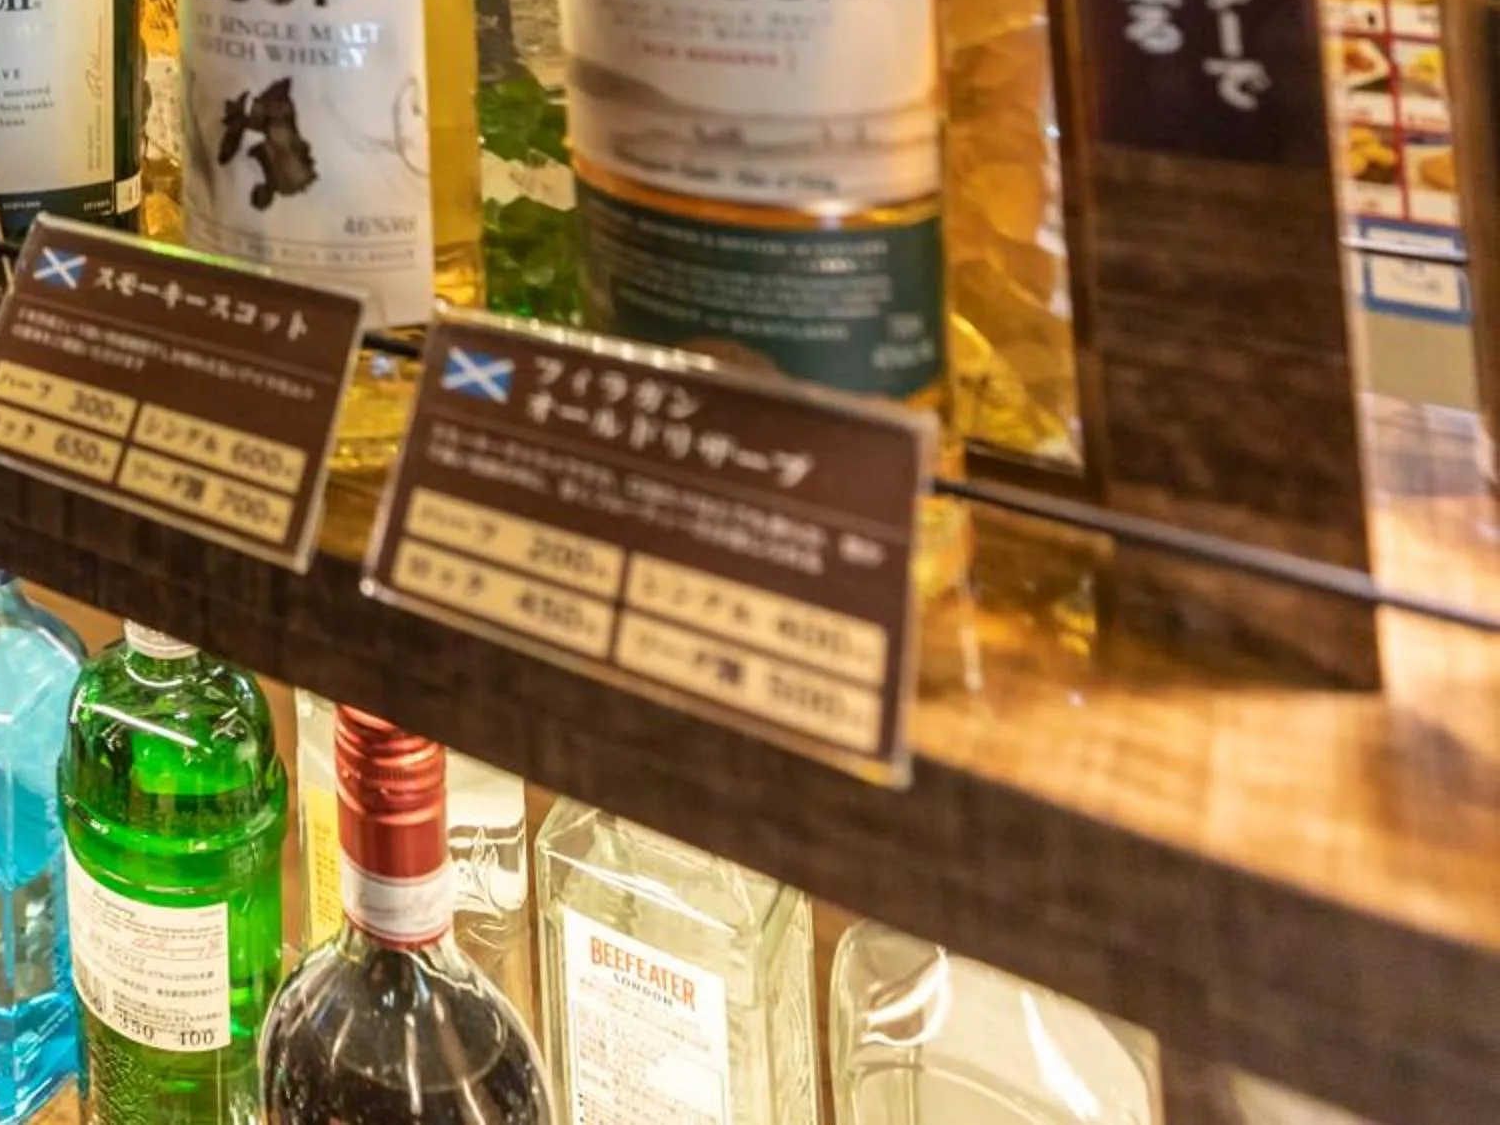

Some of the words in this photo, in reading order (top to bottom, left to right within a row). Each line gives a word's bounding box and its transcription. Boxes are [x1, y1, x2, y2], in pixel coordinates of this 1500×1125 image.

[93, 265, 308, 340] スモーキースコット
[590, 935, 697, 1012] BEEFEATER
[613, 972, 674, 1007] LONDON
